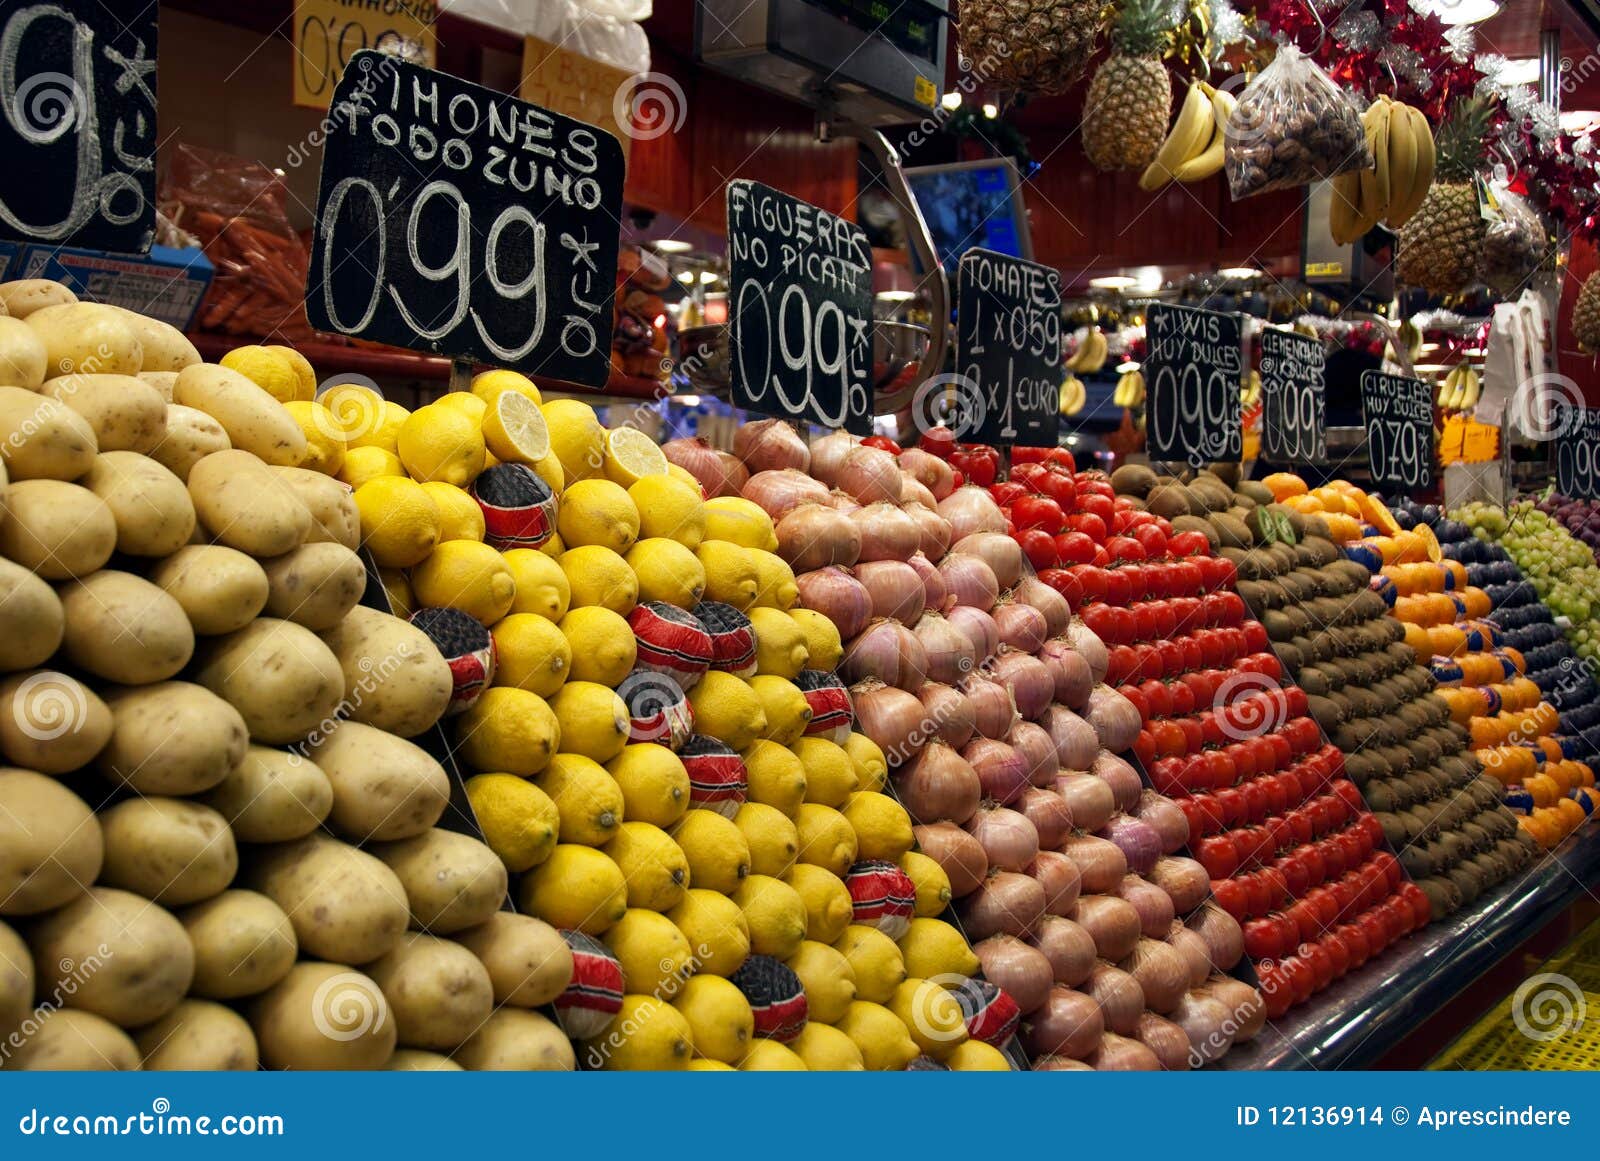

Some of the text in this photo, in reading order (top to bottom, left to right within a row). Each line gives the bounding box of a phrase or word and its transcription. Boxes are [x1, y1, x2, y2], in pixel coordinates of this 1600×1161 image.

[344, 97, 473, 170] TODO
[483, 145, 602, 211] ZUMO
[732, 186, 872, 271] FIGUERAS
[733, 231, 768, 269] NO
[320, 175, 547, 361] 0'99
[963, 255, 1060, 307] TOMATES
[736, 278, 849, 428] 0'99
[967, 297, 984, 354] 1
[1192, 341, 1240, 374] DULCES
[1366, 395, 1433, 427] MUY DULCES
